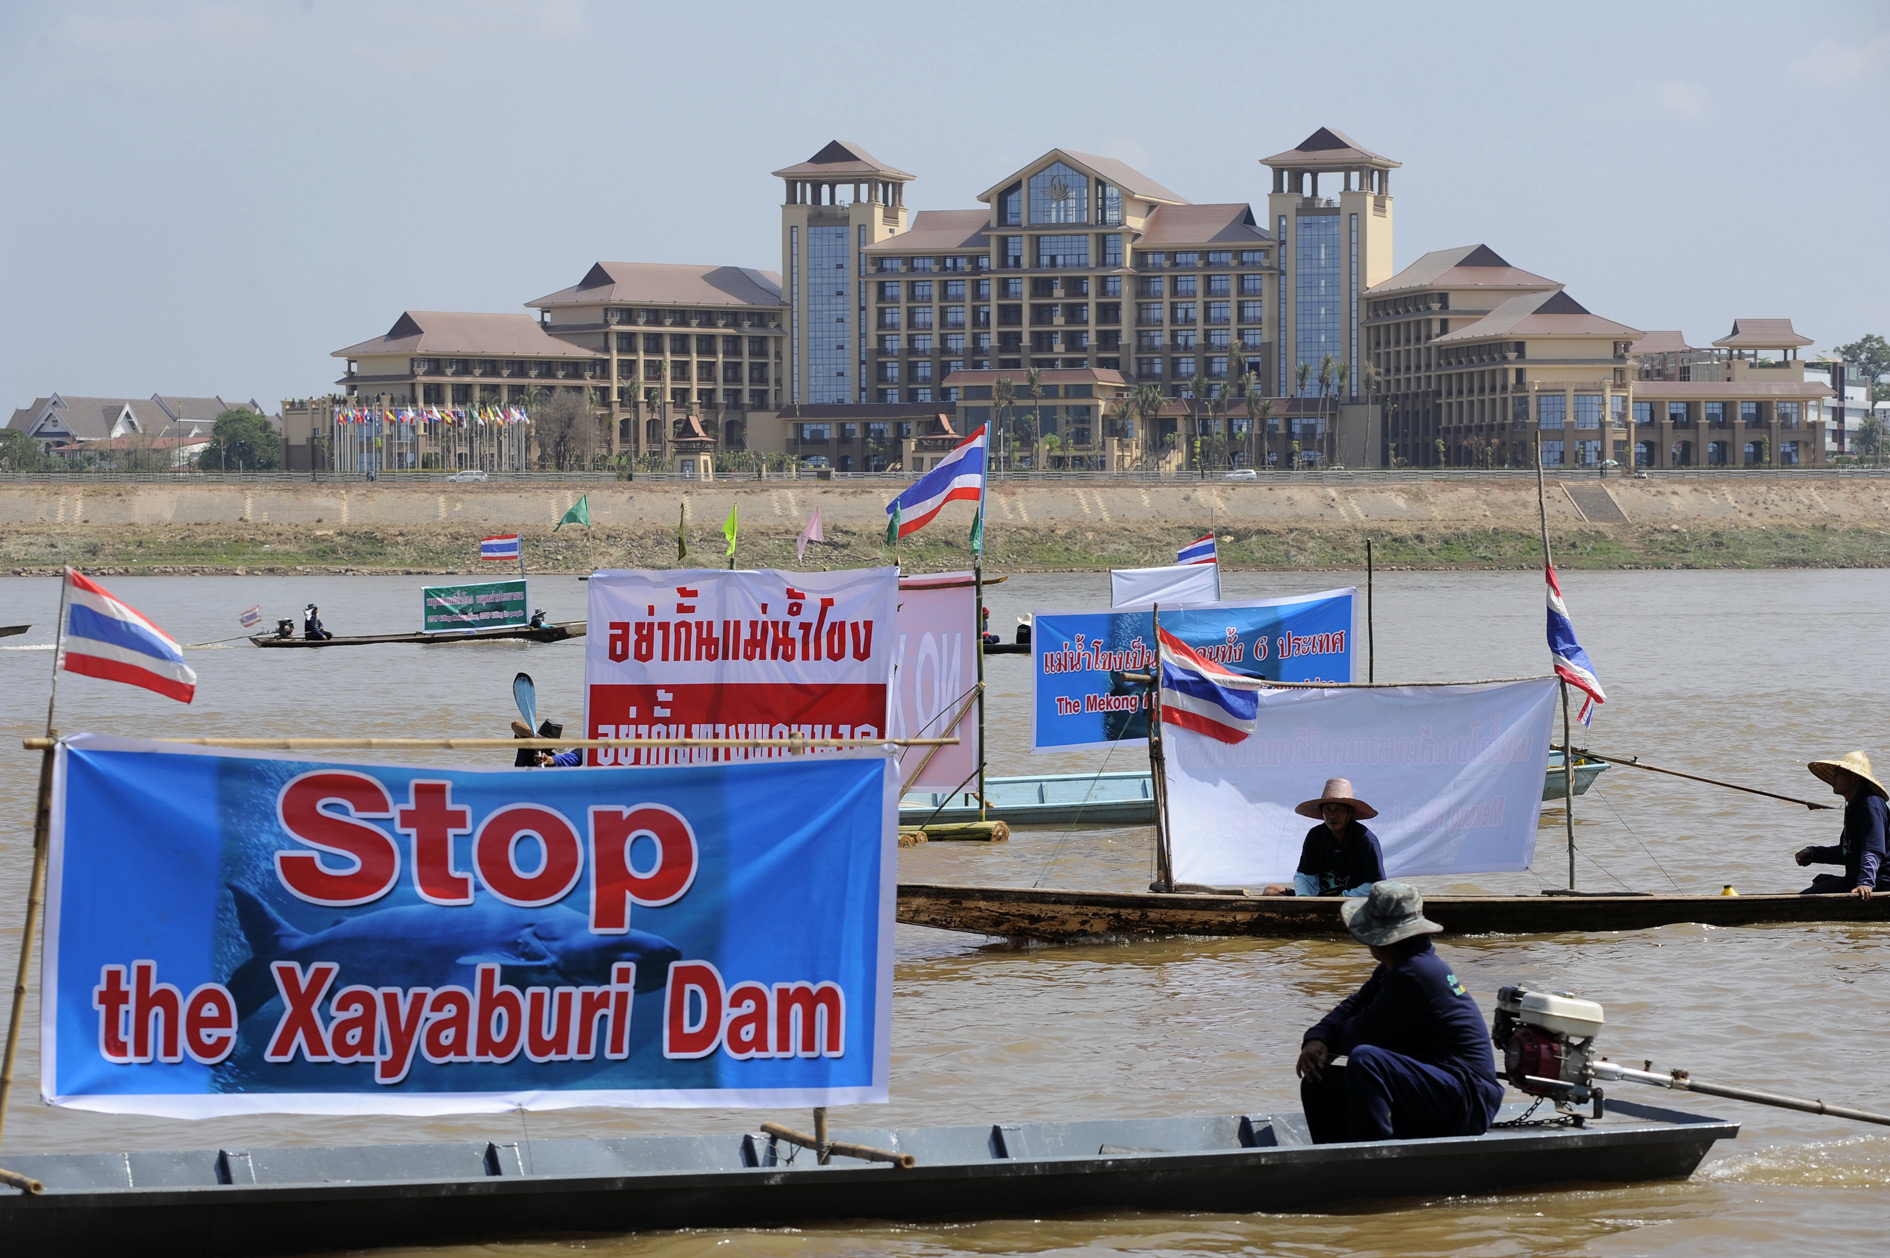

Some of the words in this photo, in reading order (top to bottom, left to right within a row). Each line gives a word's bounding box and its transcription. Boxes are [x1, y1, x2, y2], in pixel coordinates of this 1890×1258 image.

[608, 586, 874, 663] อย่ากั้นแม่น้ำโขง
[1253, 636, 1270, 662] 6
[1276, 629, 1347, 660] ประเทศ
[1055, 696, 1081, 717] The
[1085, 692, 1139, 715] Mekong
[275, 769, 698, 935] Stop
[93, 959, 238, 1064] the
[265, 960, 635, 1085] Xayaburi
[663, 959, 845, 1061] Dam
